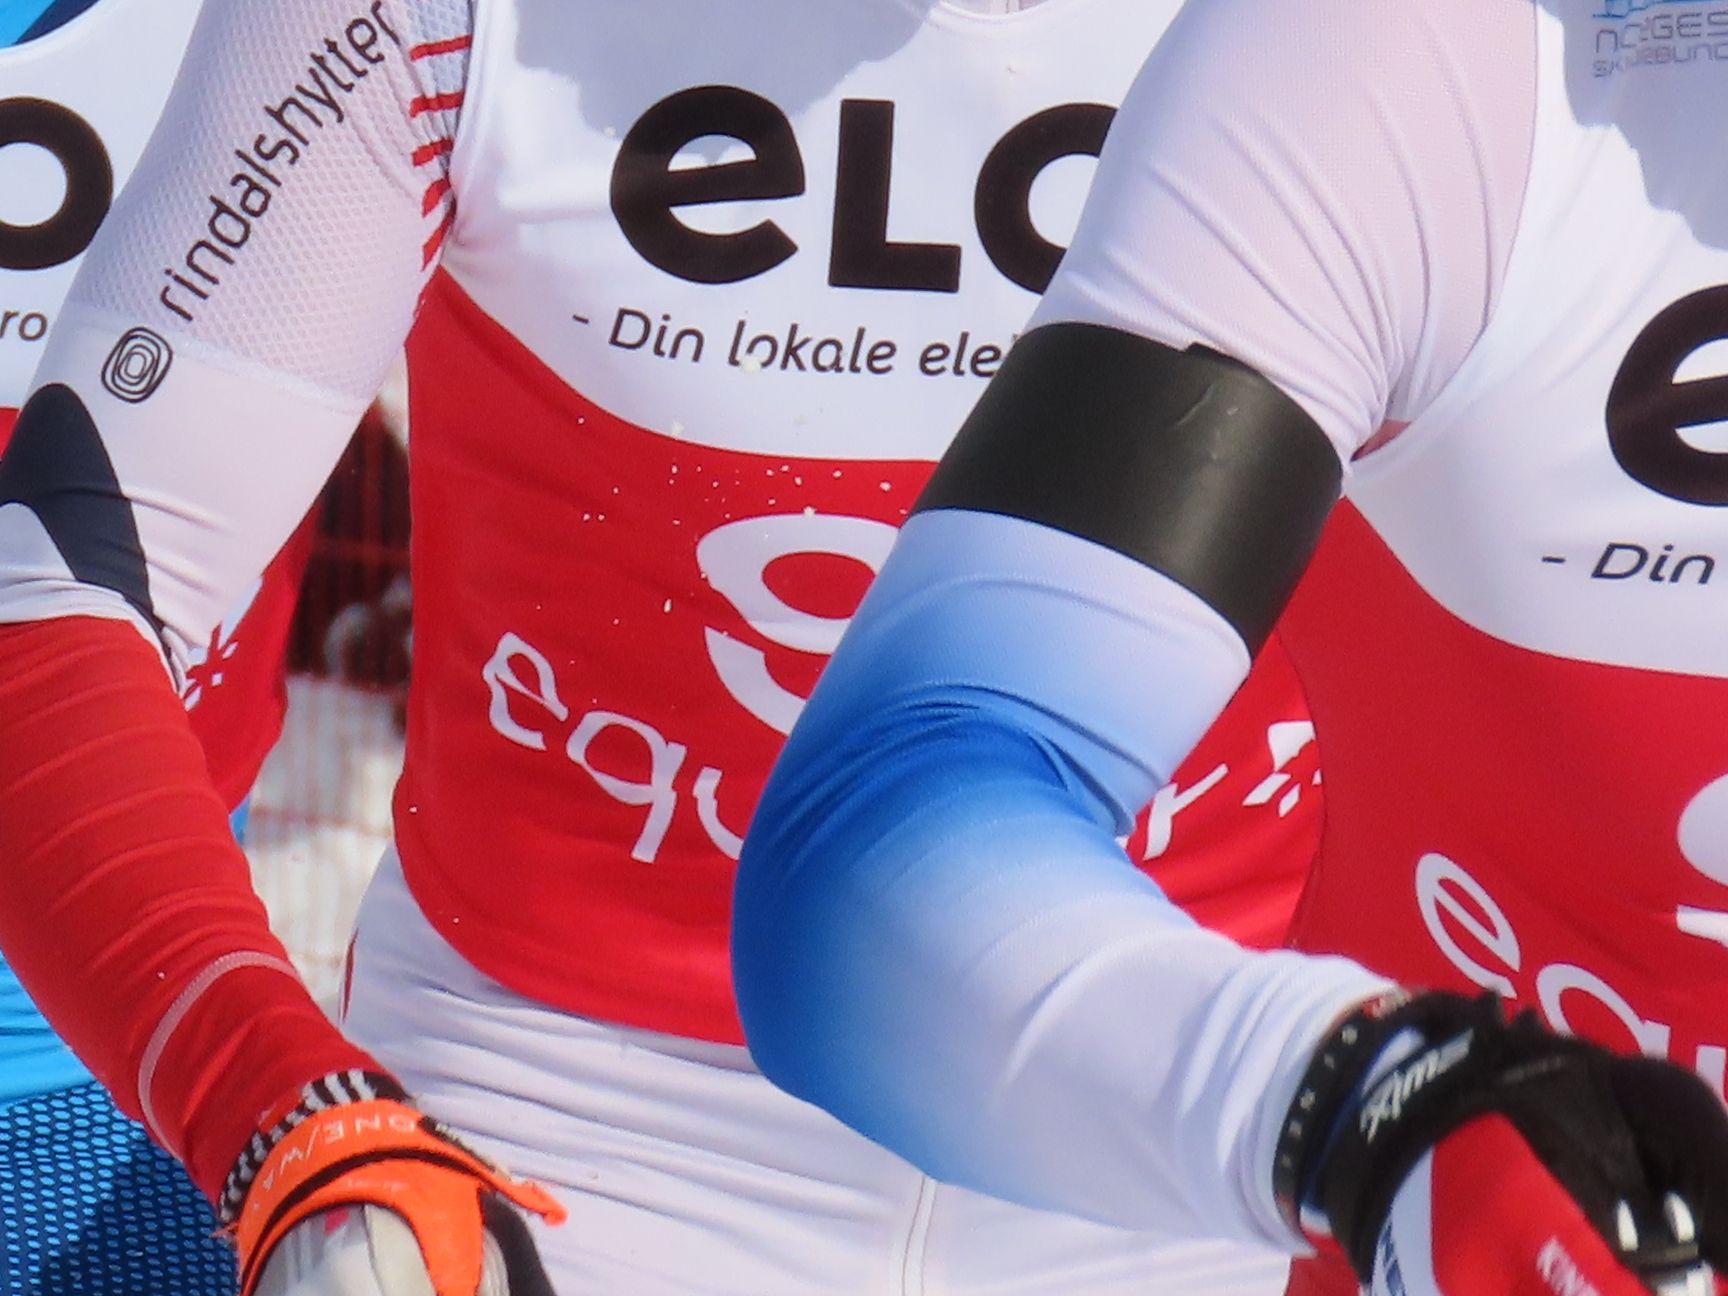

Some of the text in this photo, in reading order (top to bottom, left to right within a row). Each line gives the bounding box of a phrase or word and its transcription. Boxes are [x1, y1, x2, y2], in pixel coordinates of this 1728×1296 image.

[160, 0, 400, 321] rindalshytter
[609, 308, 704, 364] Din
[729, 318, 897, 376] lokale
[918, 330, 1018, 378] ele
[1591, 541, 1715, 587] Din
